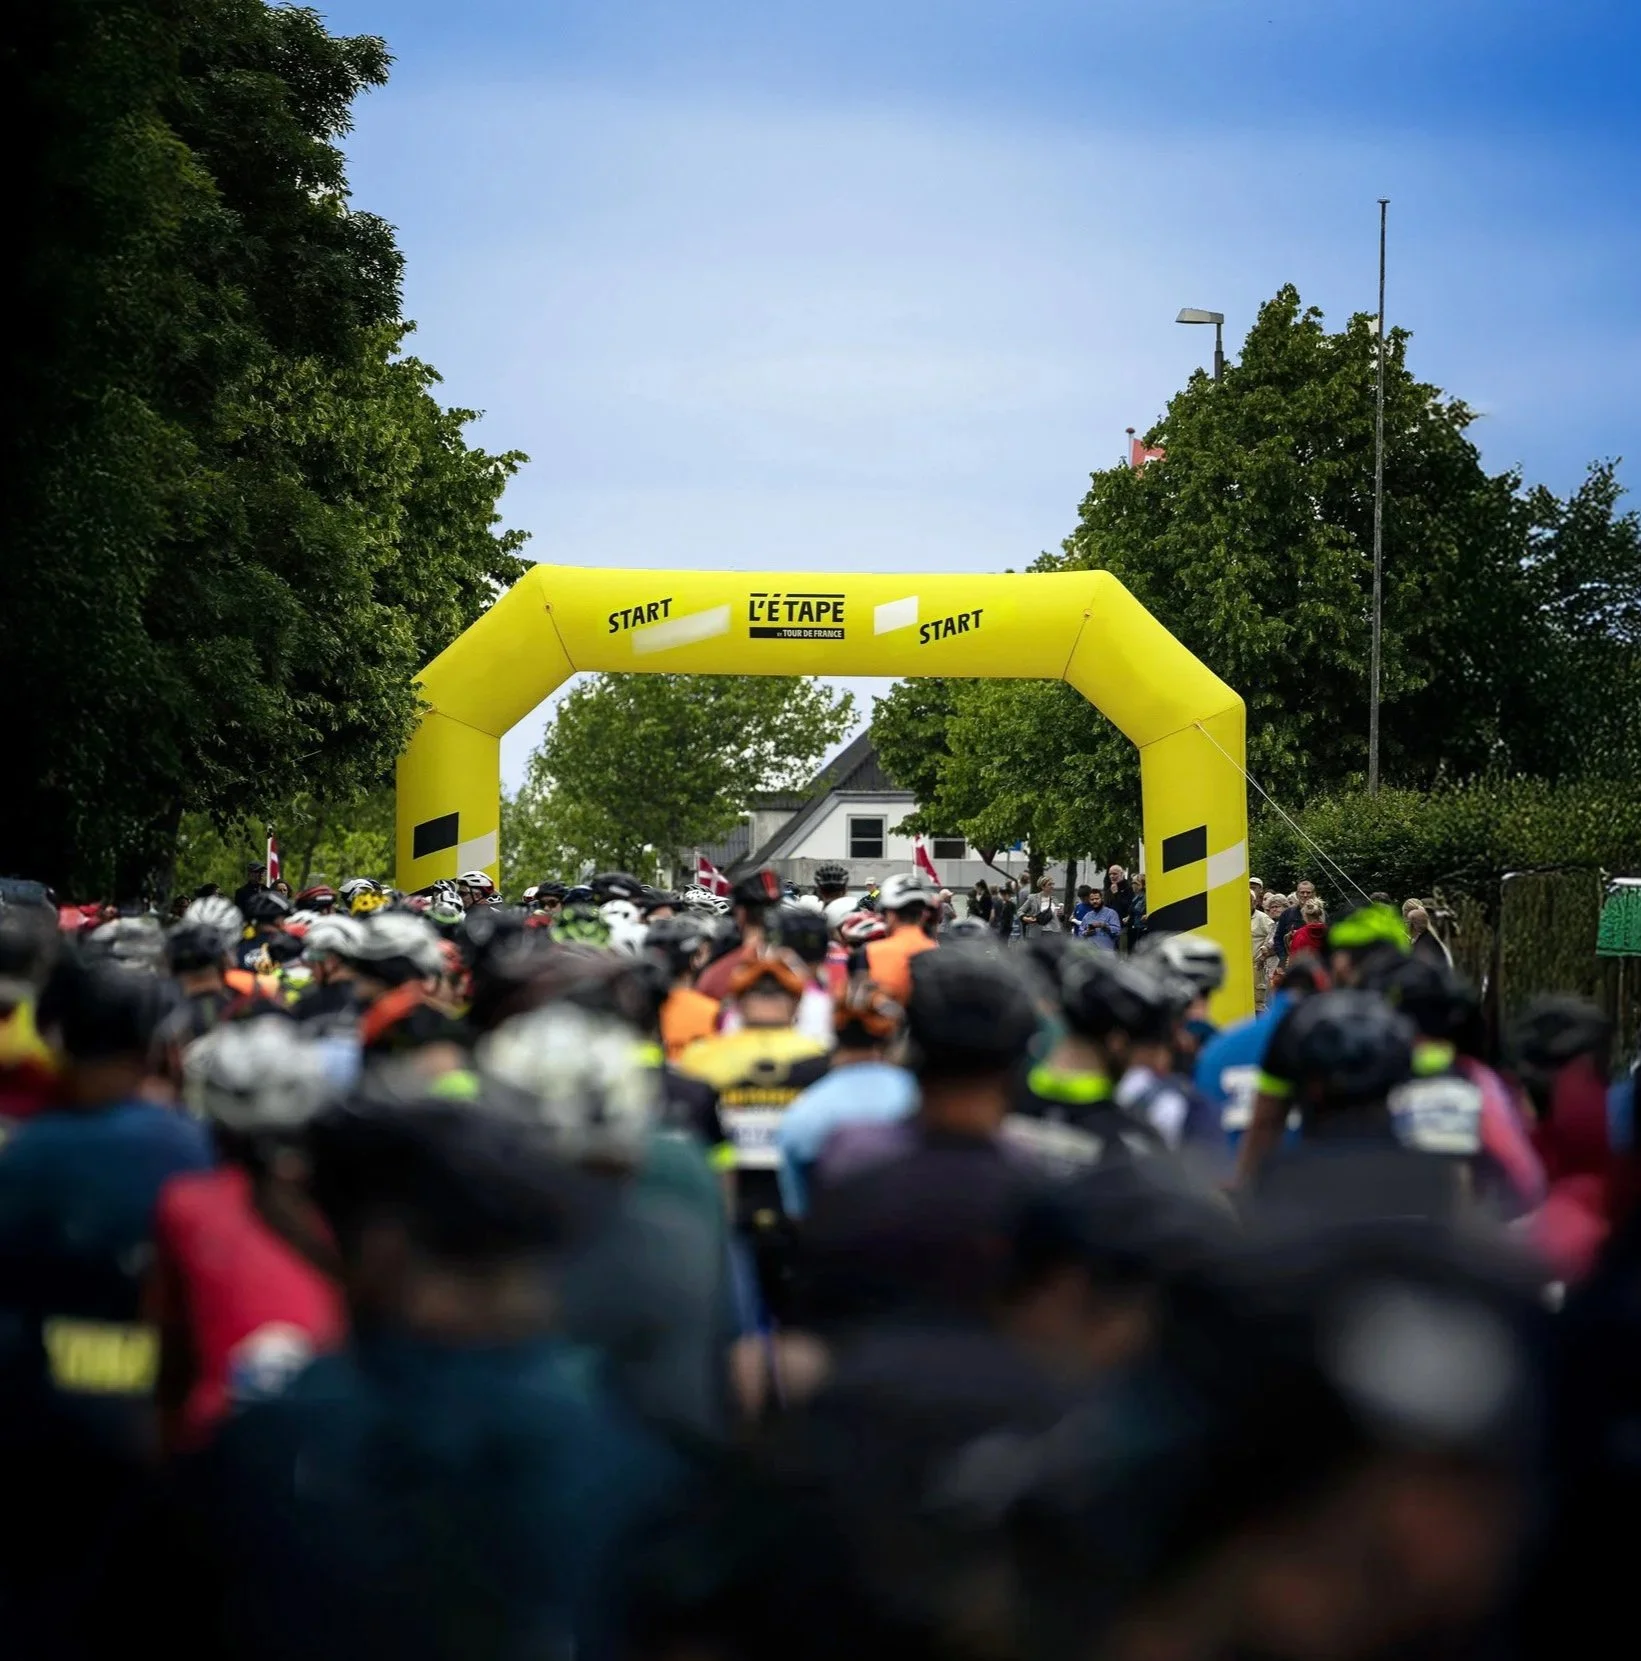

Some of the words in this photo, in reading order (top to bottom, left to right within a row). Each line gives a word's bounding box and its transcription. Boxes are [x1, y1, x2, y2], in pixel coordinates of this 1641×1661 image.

[608, 597, 673, 634] START
[783, 629, 802, 638] TOUR
[803, 629, 813, 638] DE
[814, 630, 842, 638] FRANCE
[919, 608, 984, 645] START
